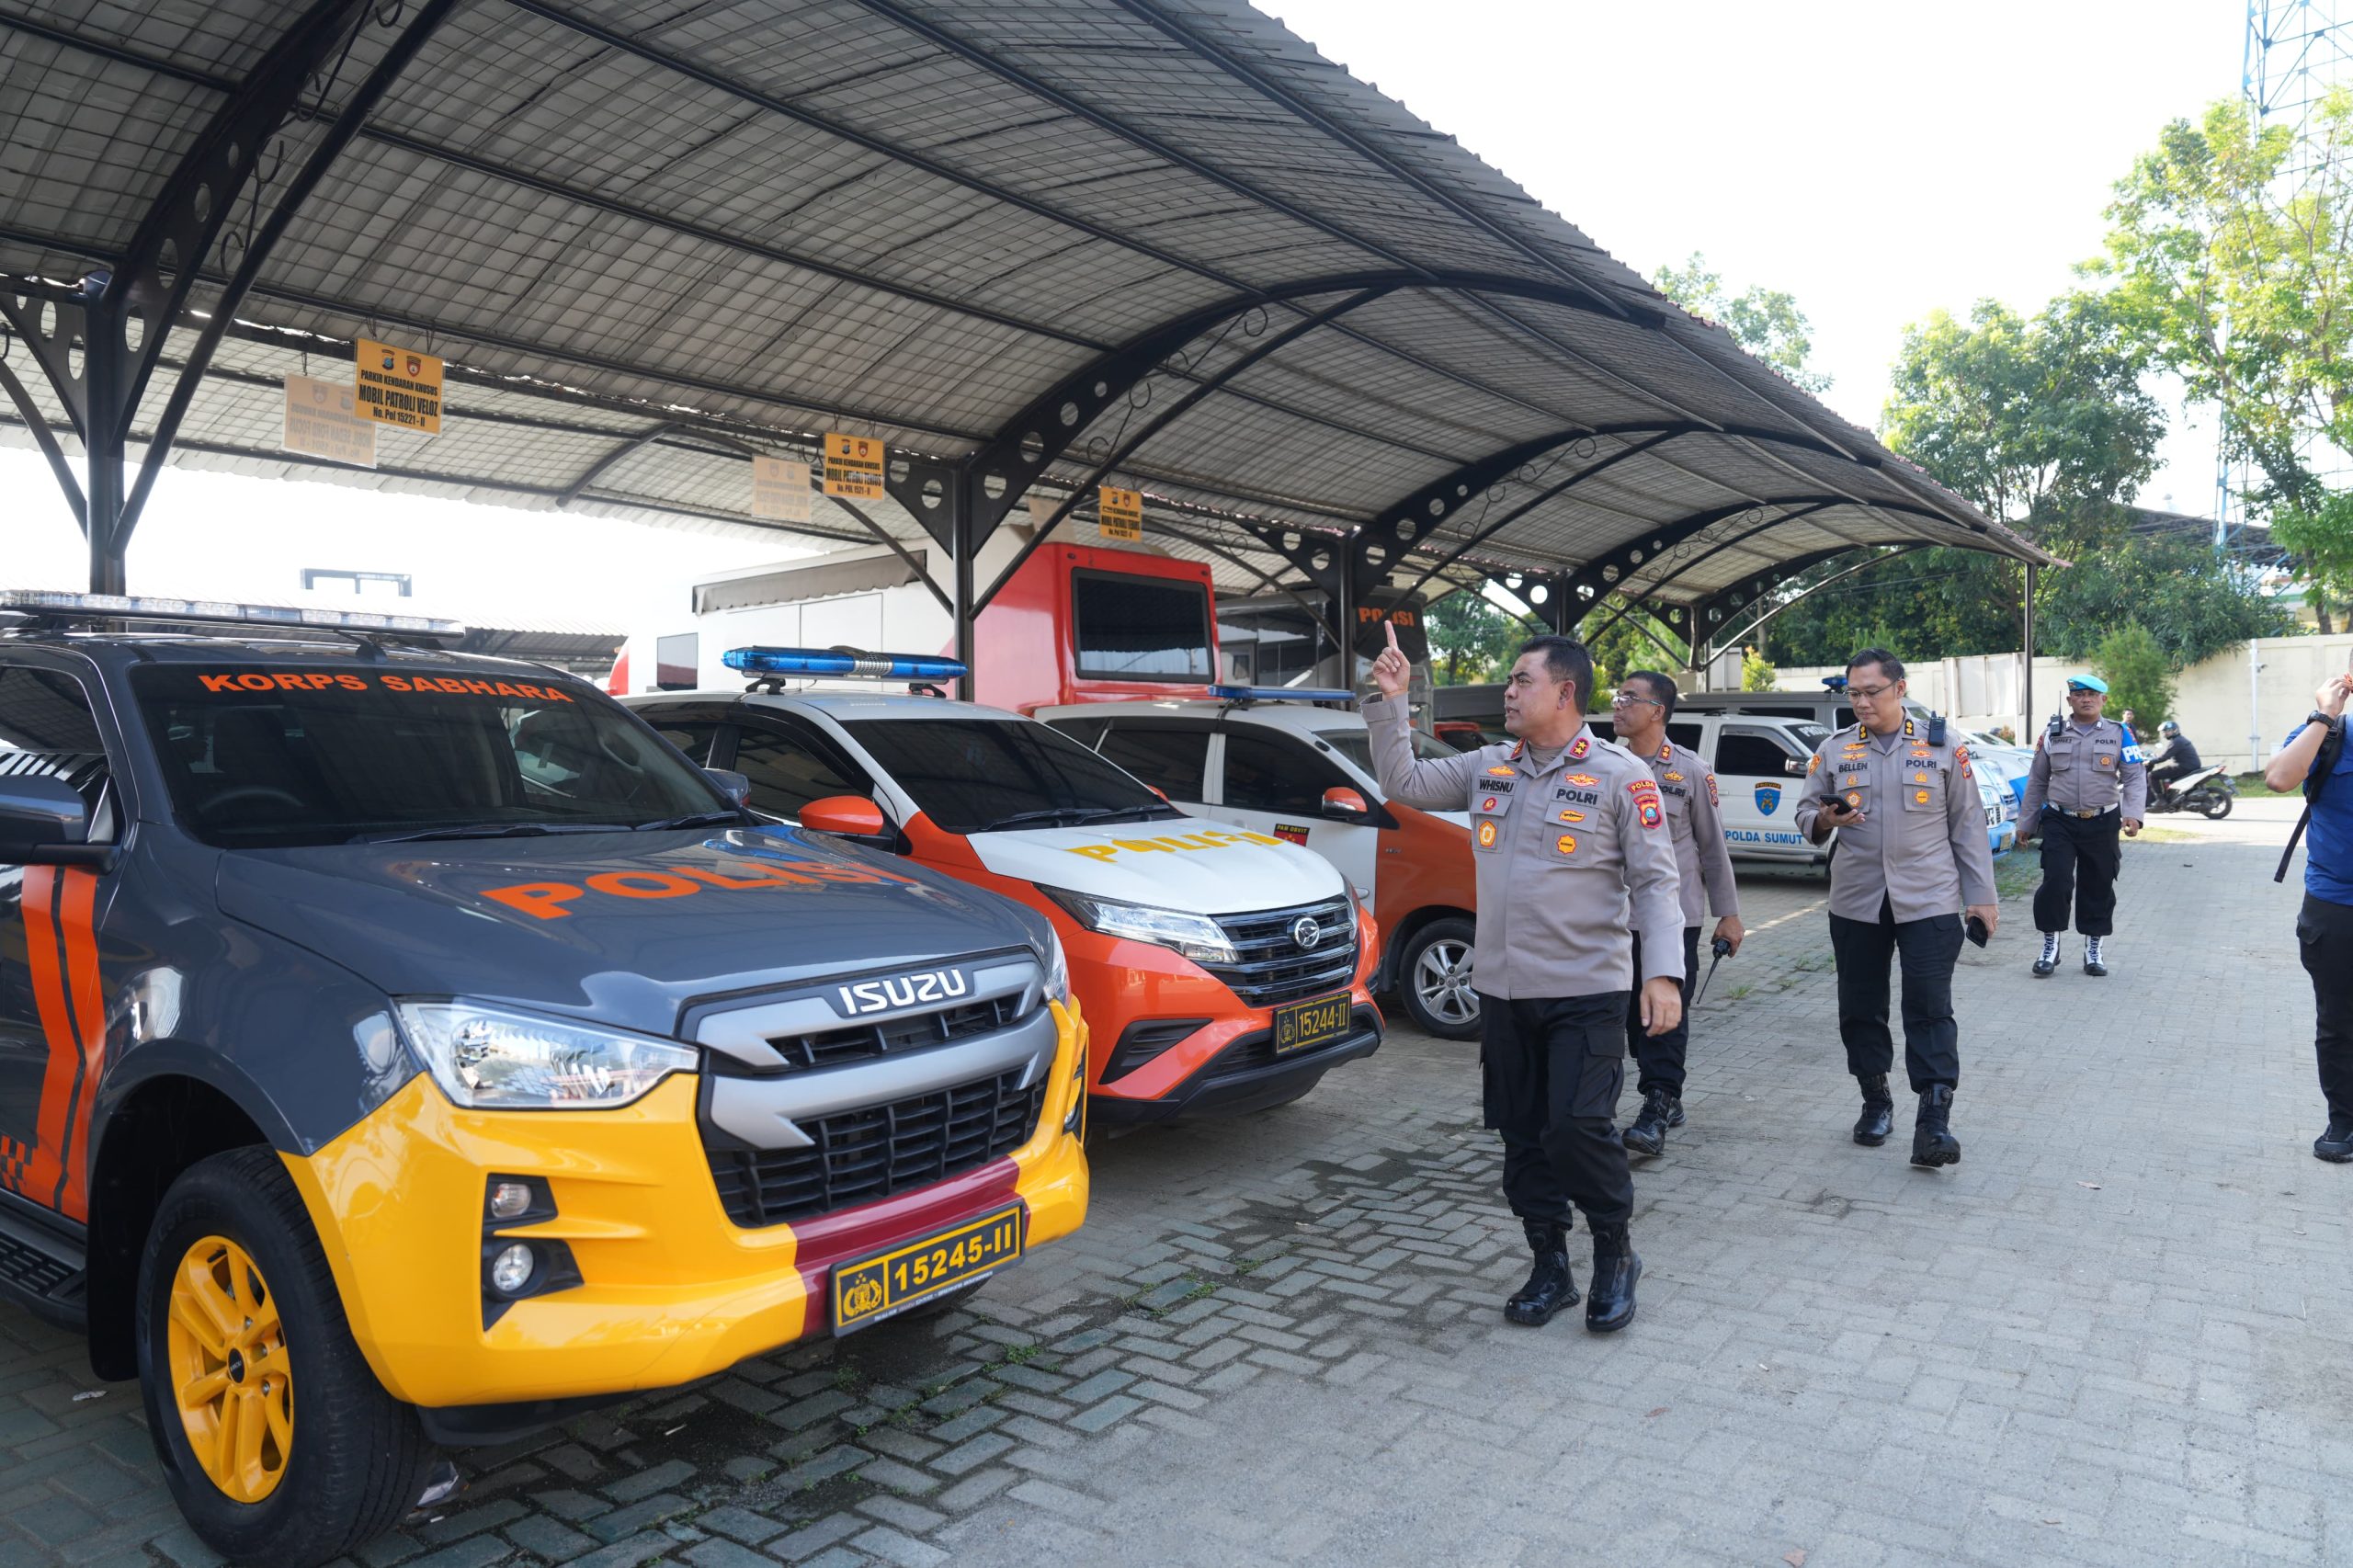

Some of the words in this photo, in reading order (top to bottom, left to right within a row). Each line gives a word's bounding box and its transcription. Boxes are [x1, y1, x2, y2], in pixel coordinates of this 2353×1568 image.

[360, 369, 383, 383] PARKIR
[358, 383, 384, 405] MOBIL
[385, 390, 415, 412] PATROLI
[416, 397, 438, 417] VELOZ
[373, 406, 384, 418] No.
[1358, 608, 1415, 627] POISI
[198, 674, 368, 692] KORPS
[380, 676, 574, 703] SABHARA
[1839, 762, 1868, 773] BELLEN
[1905, 759, 1938, 769] POLRI
[1479, 778, 1515, 793] WHISNU
[1631, 781, 1655, 791] POLDA
[1556, 788, 1598, 805] POLRI
[1725, 830, 1760, 842] POLDA
[1765, 833, 1802, 845] SUMUT
[479, 860, 919, 919] POLISI
[838, 969, 966, 1015] ISUZU
[1300, 1003, 1347, 1038] 15244-II
[894, 1222, 1011, 1291] 15245-II
